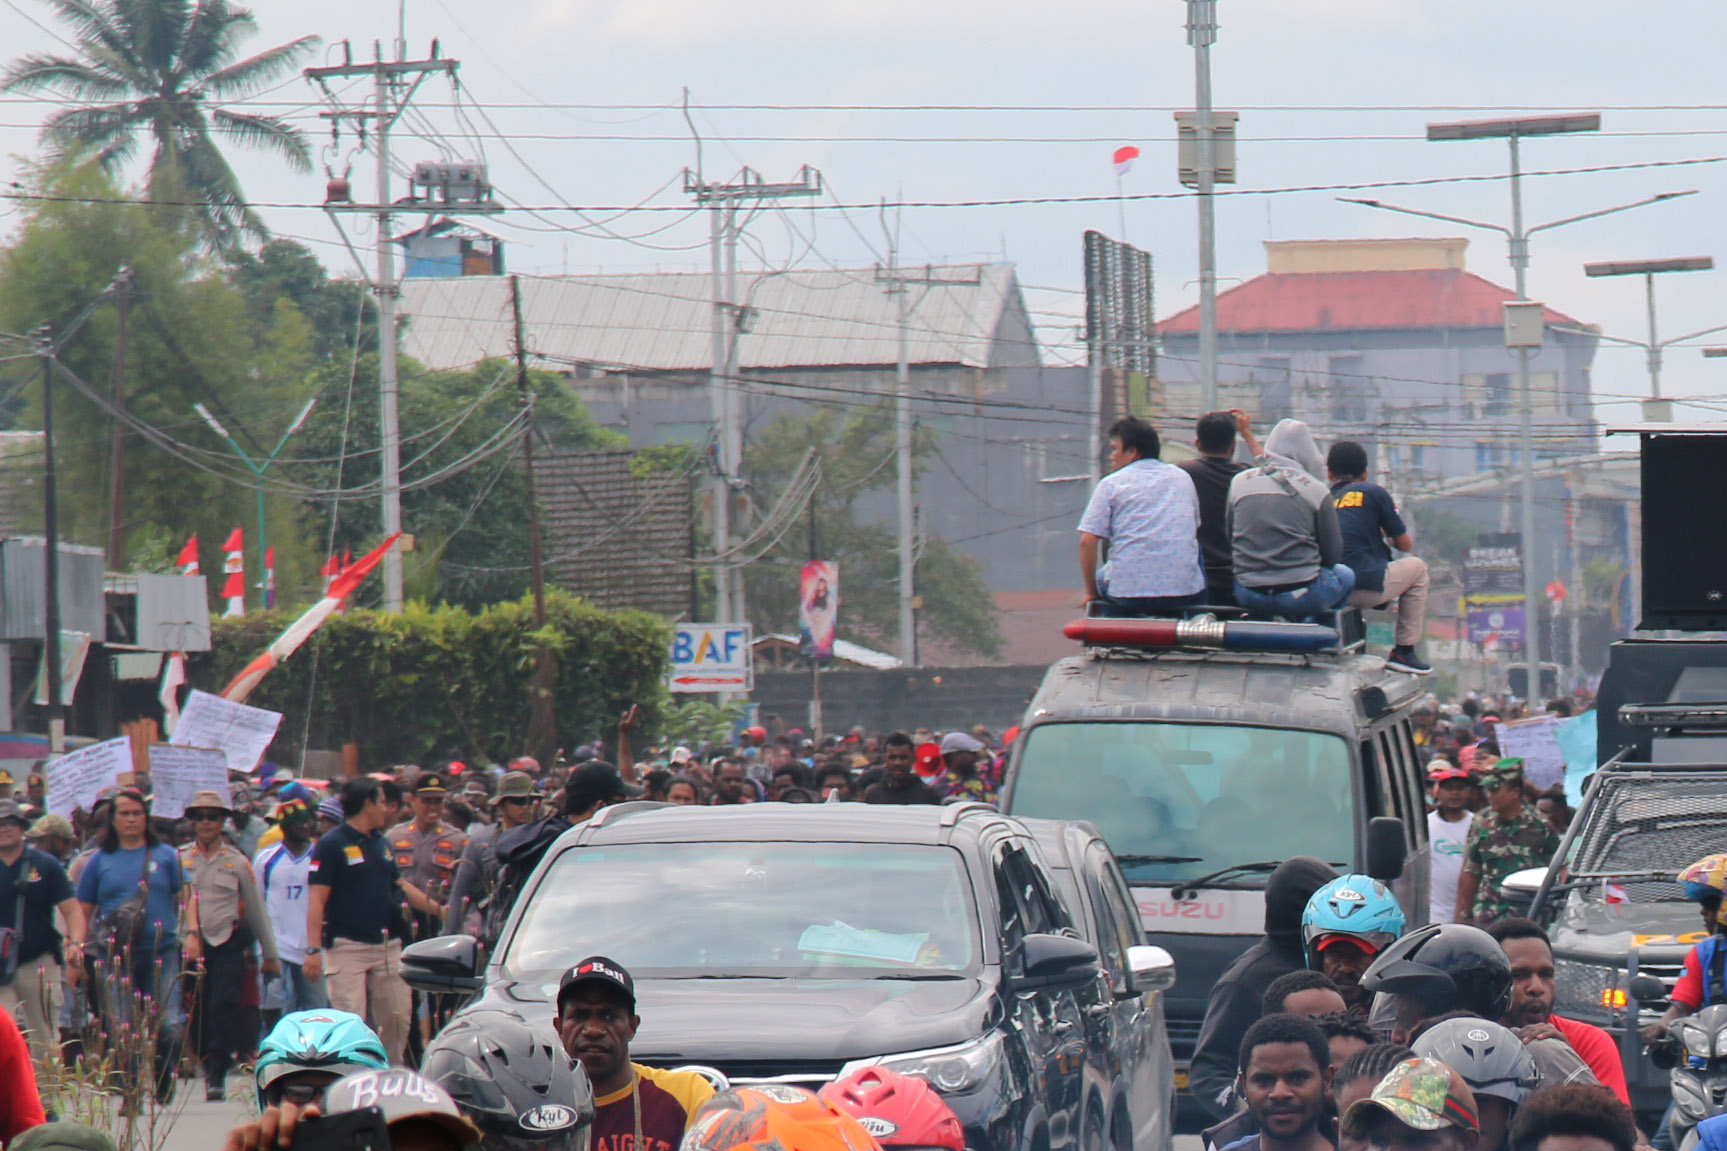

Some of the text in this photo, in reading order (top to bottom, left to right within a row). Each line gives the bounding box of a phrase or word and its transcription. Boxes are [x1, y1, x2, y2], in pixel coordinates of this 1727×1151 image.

[672, 631, 745, 665] BAF
[287, 885, 304, 900] 17
[592, 961, 625, 985] Bali
[347, 1071, 440, 1109] Bulls
